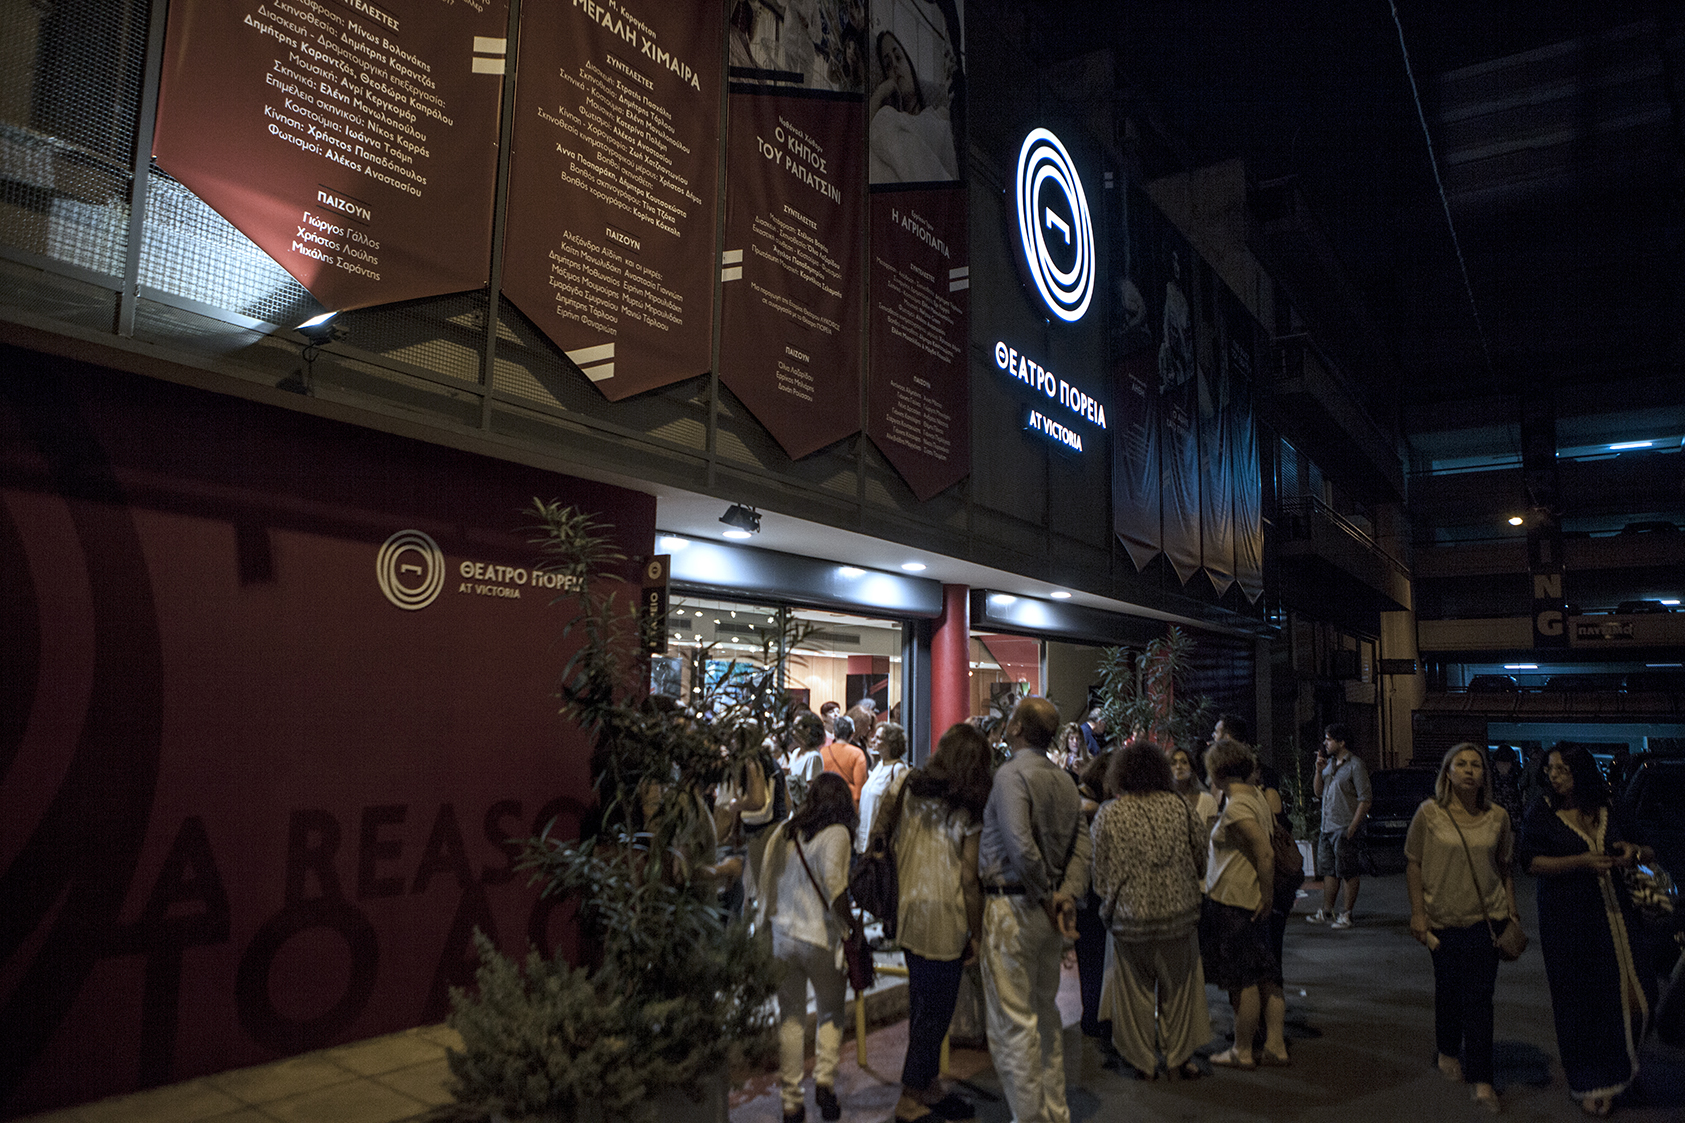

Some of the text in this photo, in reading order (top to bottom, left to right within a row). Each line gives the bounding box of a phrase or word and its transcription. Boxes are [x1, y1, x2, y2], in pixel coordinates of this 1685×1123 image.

[274, 0, 435, 89] Σκηνοθεσία: Δημήτρης Καραντζάς
[348, 20, 379, 45] Μίνως
[382, 38, 431, 72] Βολανάκης
[572, 0, 701, 92] ΜΕΓΑΛΗ ΧΙΜΑΙΡΑ
[620, 5, 658, 40] Καραγάτση
[244, 14, 453, 126] Δημήτρης Καραντζάς, Θεοδώρα Καπράλου
[257, 4, 446, 108] Διασκευή Δραματουργική επεξεργασία:
[266, 72, 430, 158] Επιμέλεια σκηνικού: Νίκος Καρράς
[273, 59, 426, 142] Σκηνικά: Ελένη Μανωλοπούλου
[289, 51, 416, 123] Μουσική: Ανρί Κεργκομάρ
[264, 104, 427, 185] Κίνηση: Χρήστος Παπαδόπουλος
[268, 123, 421, 197] Φωτισμοί: Αλέκος Αναστασίου
[285, 97, 413, 164] Κοστούμια: Ιωάννα Τσάμη
[775, 126, 828, 174] Ο ΚΗΠΟΣ
[756, 136, 842, 205] ΤΟΥ ΡΑΠΑΤΣΙΝΙ
[303, 211, 379, 249] Γιώργος Γάλλος
[317, 191, 370, 220] ΠΑΙΖΟΥΝ
[892, 208, 899, 224] Η
[901, 215, 950, 260] ΑΓΡΙΟΠΑΠΙΑ
[292, 240, 380, 281] Μιχάλης Σαράντης
[296, 225, 378, 265] Χρήστος Λούλης
[785, 346, 810, 362] ΠΑΙΖΟΥΝ
[994, 340, 1057, 398] ΘΕΑΤΡΟ
[1059, 379, 1107, 429] ΠΟΡΕΙΑ
[1029, 410, 1083, 452] AT VICTORIA
[459, 560, 528, 585] ΘΕΑΤΡΟ
[459, 582, 521, 600] AT VICTORIA
